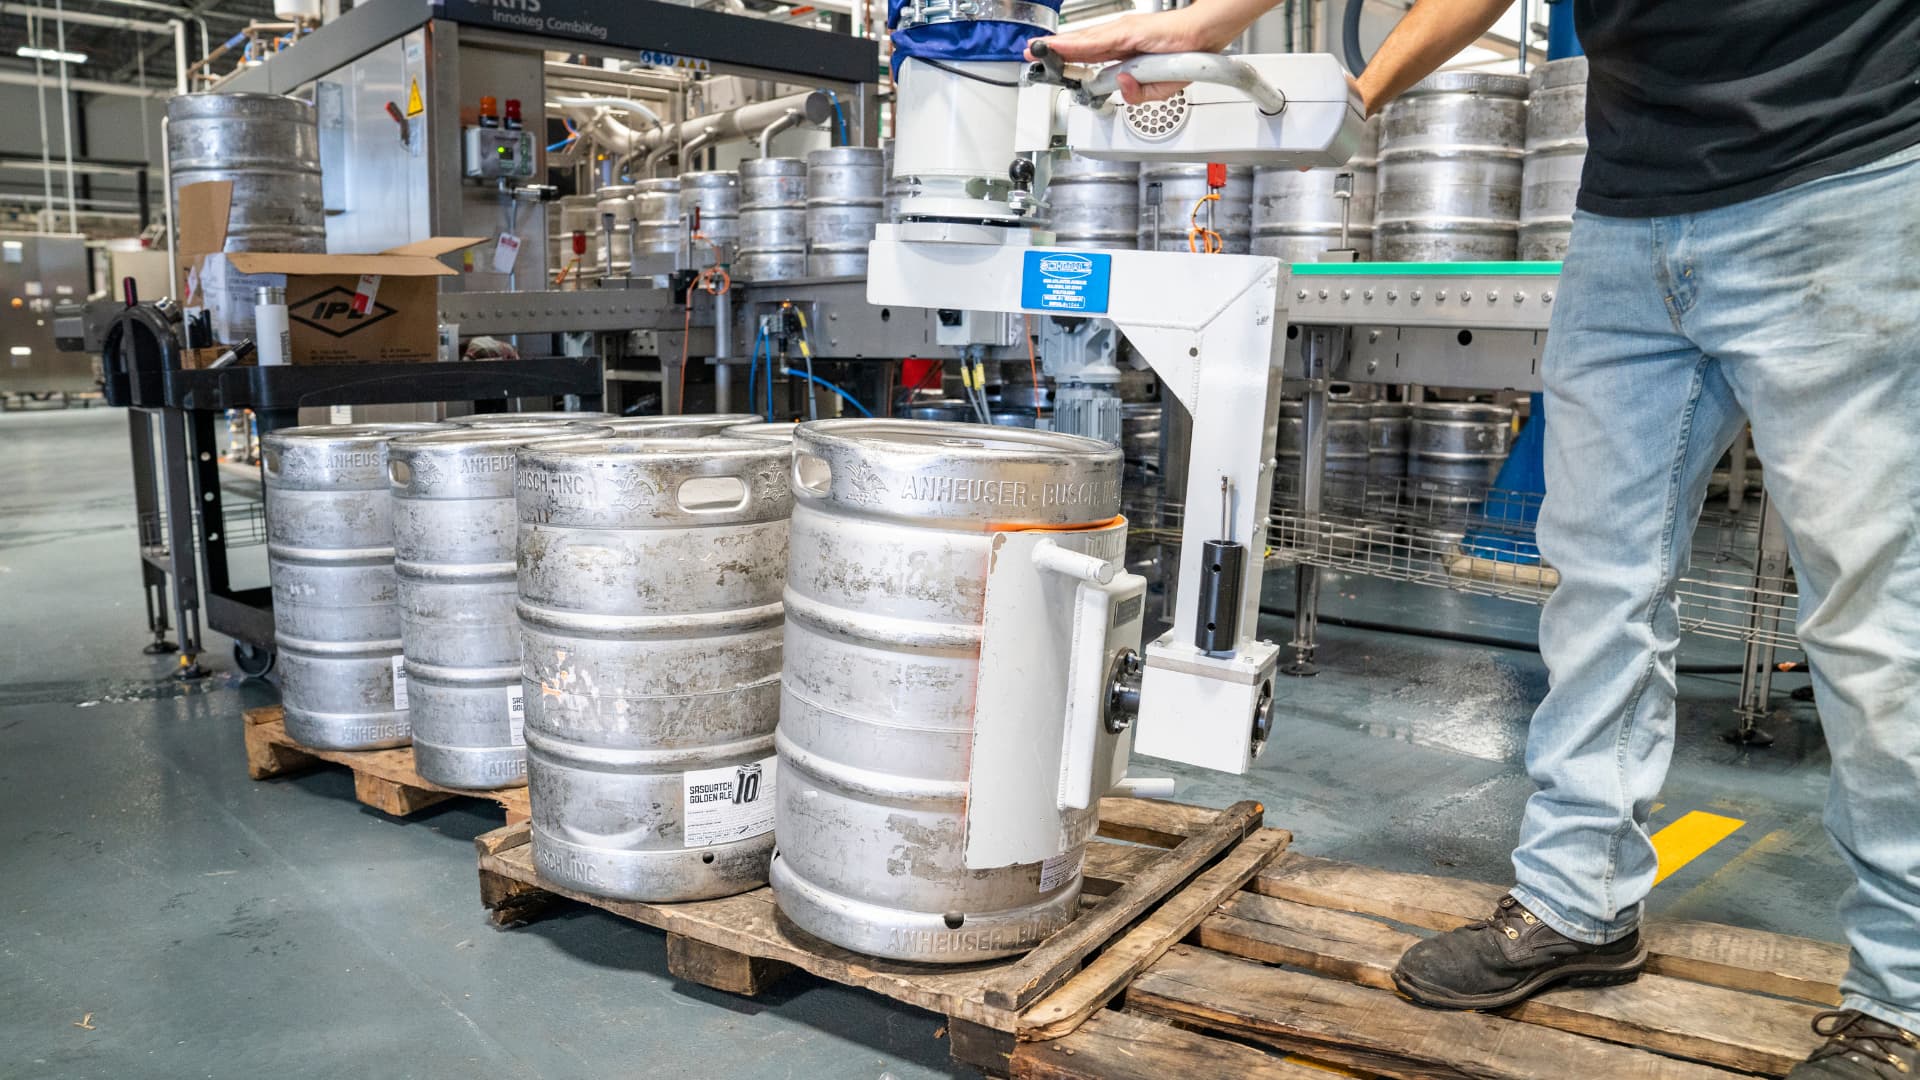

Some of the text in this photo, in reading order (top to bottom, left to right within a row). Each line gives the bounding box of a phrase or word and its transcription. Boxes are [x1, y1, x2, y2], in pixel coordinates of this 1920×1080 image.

[493, 9, 608, 40] Innokeg CombiKeg
[689, 781, 733, 795] SASQUATCH
[689, 790, 733, 804] GOLDEN ALE
[733, 773, 760, 805] 10
